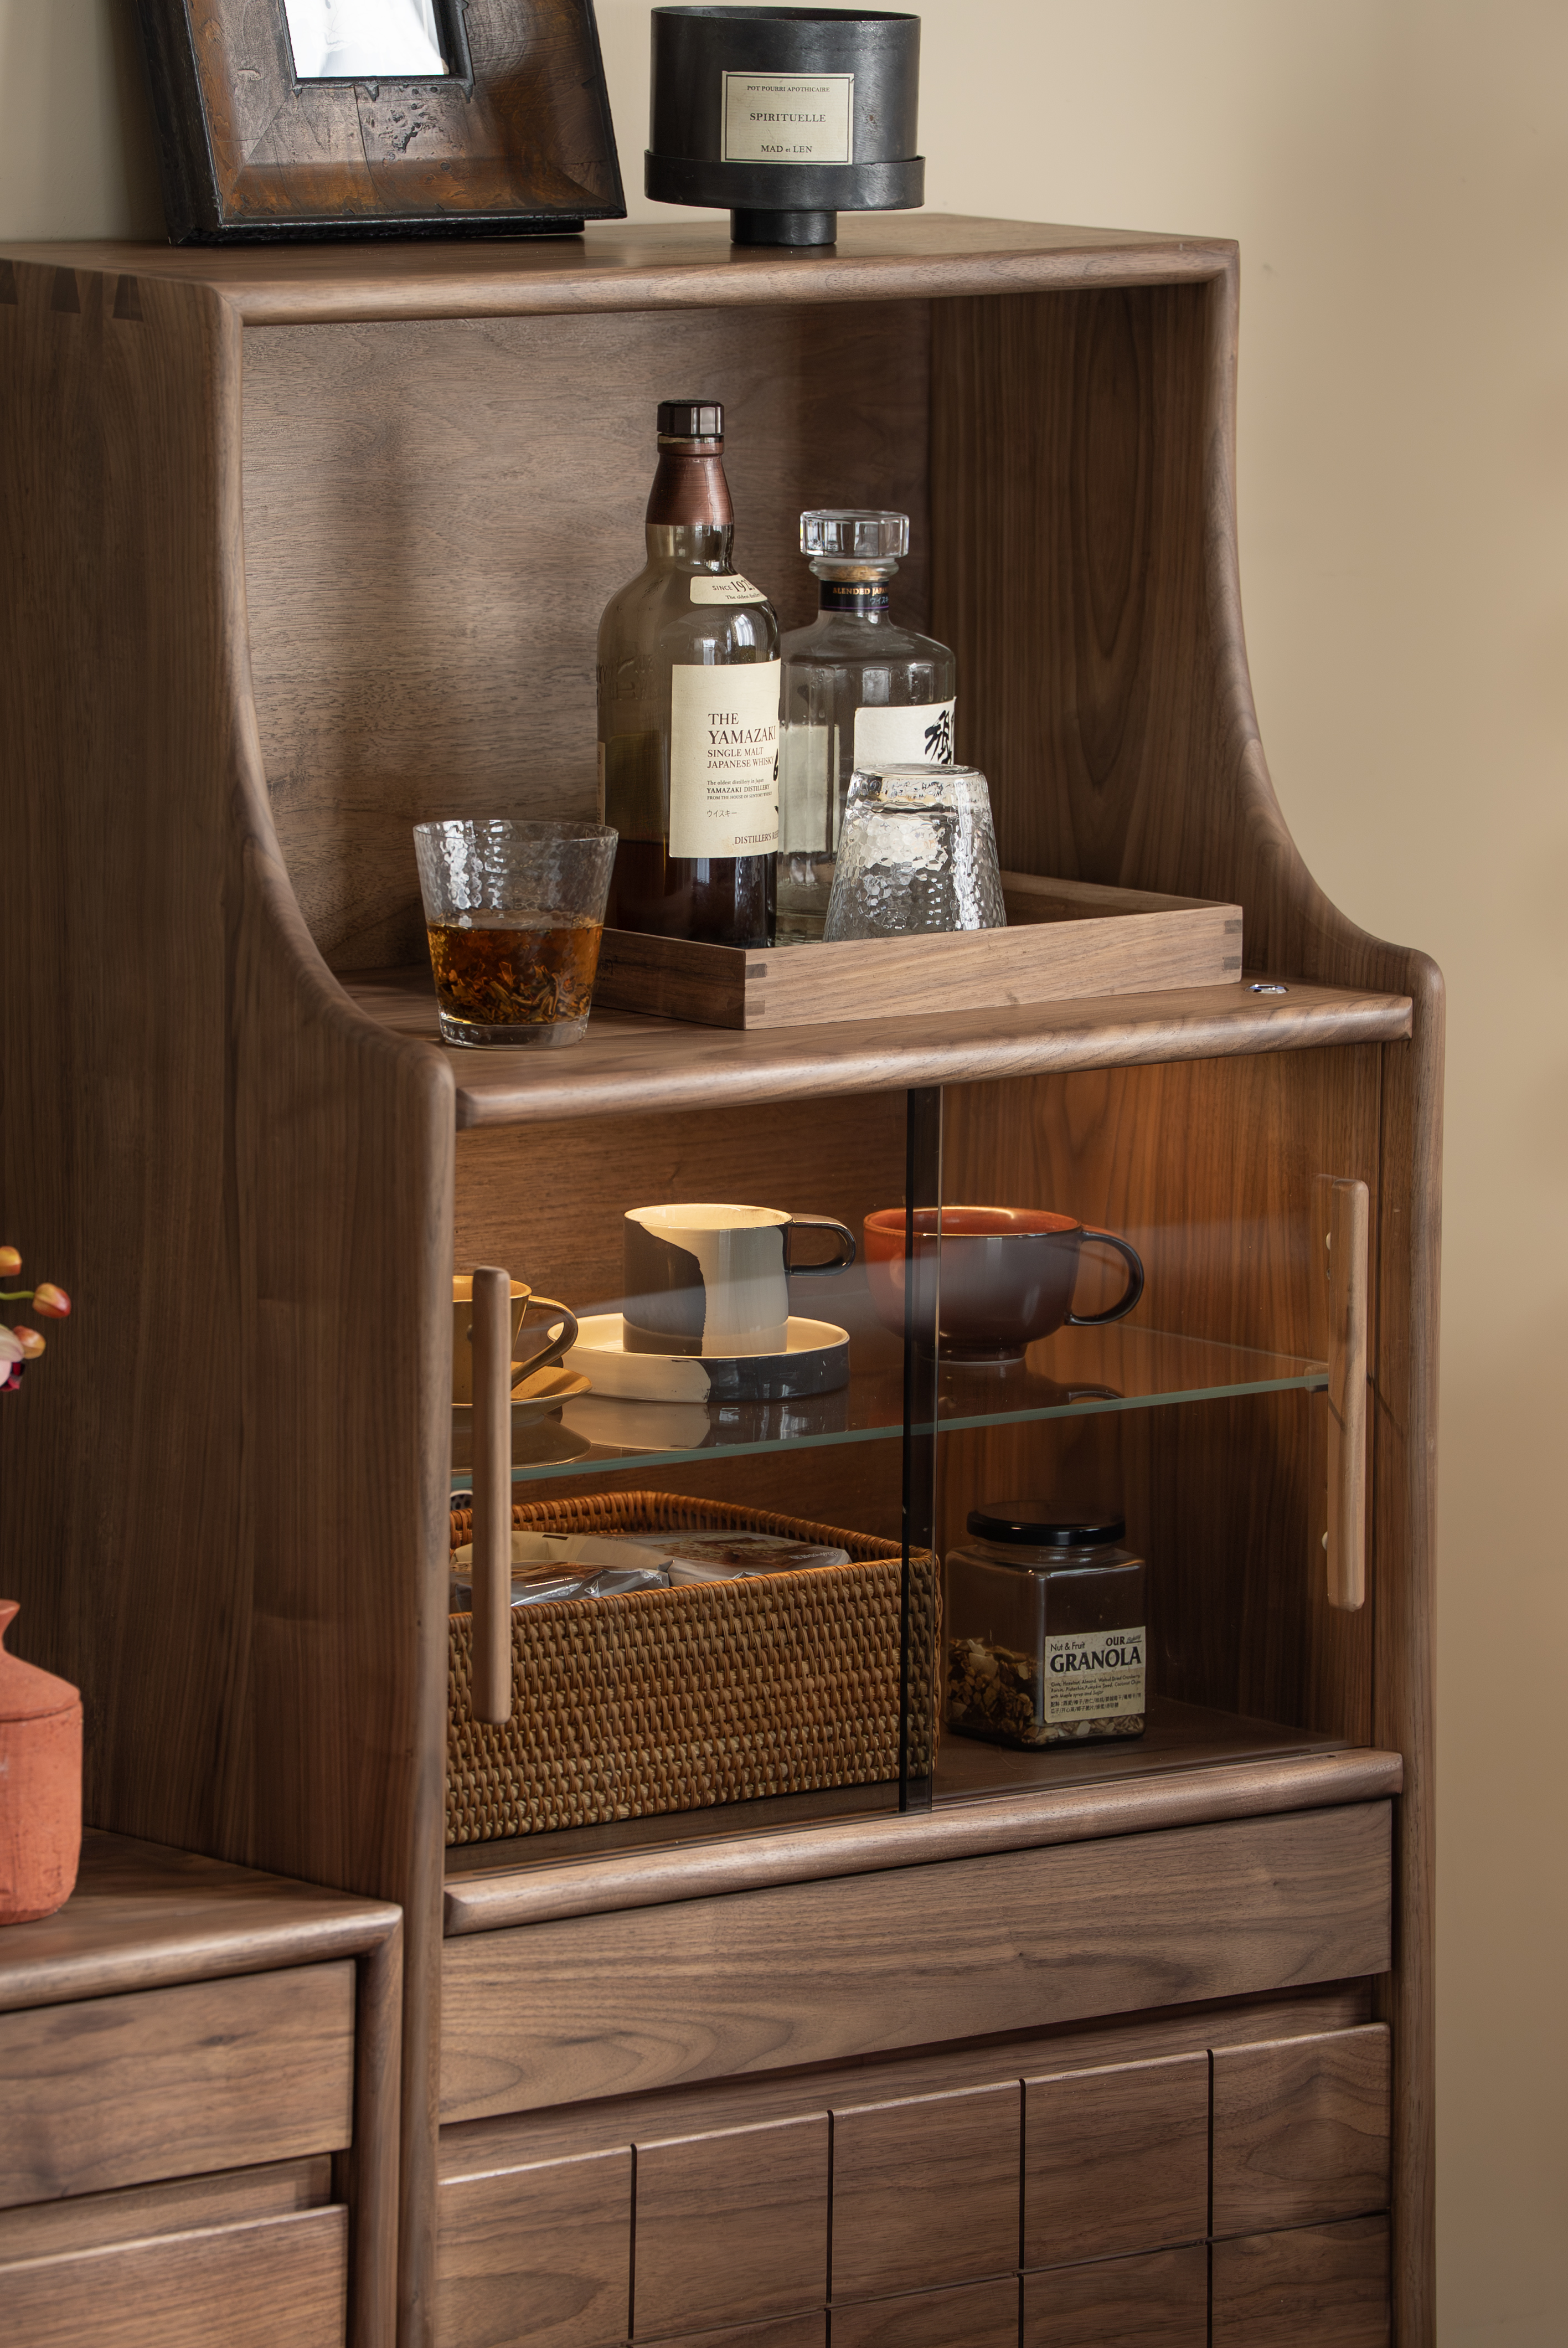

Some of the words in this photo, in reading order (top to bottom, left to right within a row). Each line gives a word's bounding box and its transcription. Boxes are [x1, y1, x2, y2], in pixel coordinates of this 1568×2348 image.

[750, 112, 826, 122] SPIRITUELLE
[761, 145, 783, 153] MAD
[833, 587, 870, 595] BLENDED
[708, 713, 739, 725] THE
[708, 725, 776, 744] YAMAZAKI
[707, 749, 742, 758] SINGLE
[744, 747, 764, 756] MALT
[707, 759, 751, 769] JAPANESE
[752, 756, 774, 766] WHISKY
[744, 784, 770, 792] DISTILLERY
[706, 809, 737, 818] ウイスキー
[734, 833, 772, 845] DISTILLER'S
[1050, 1643, 1063, 1652] Nut
[1064, 1642, 1070, 1651] &
[1071, 1641, 1085, 1650] Fruit
[1106, 1636, 1126, 1646] OUR
[1050, 1645, 1142, 1673] GRANOLA
